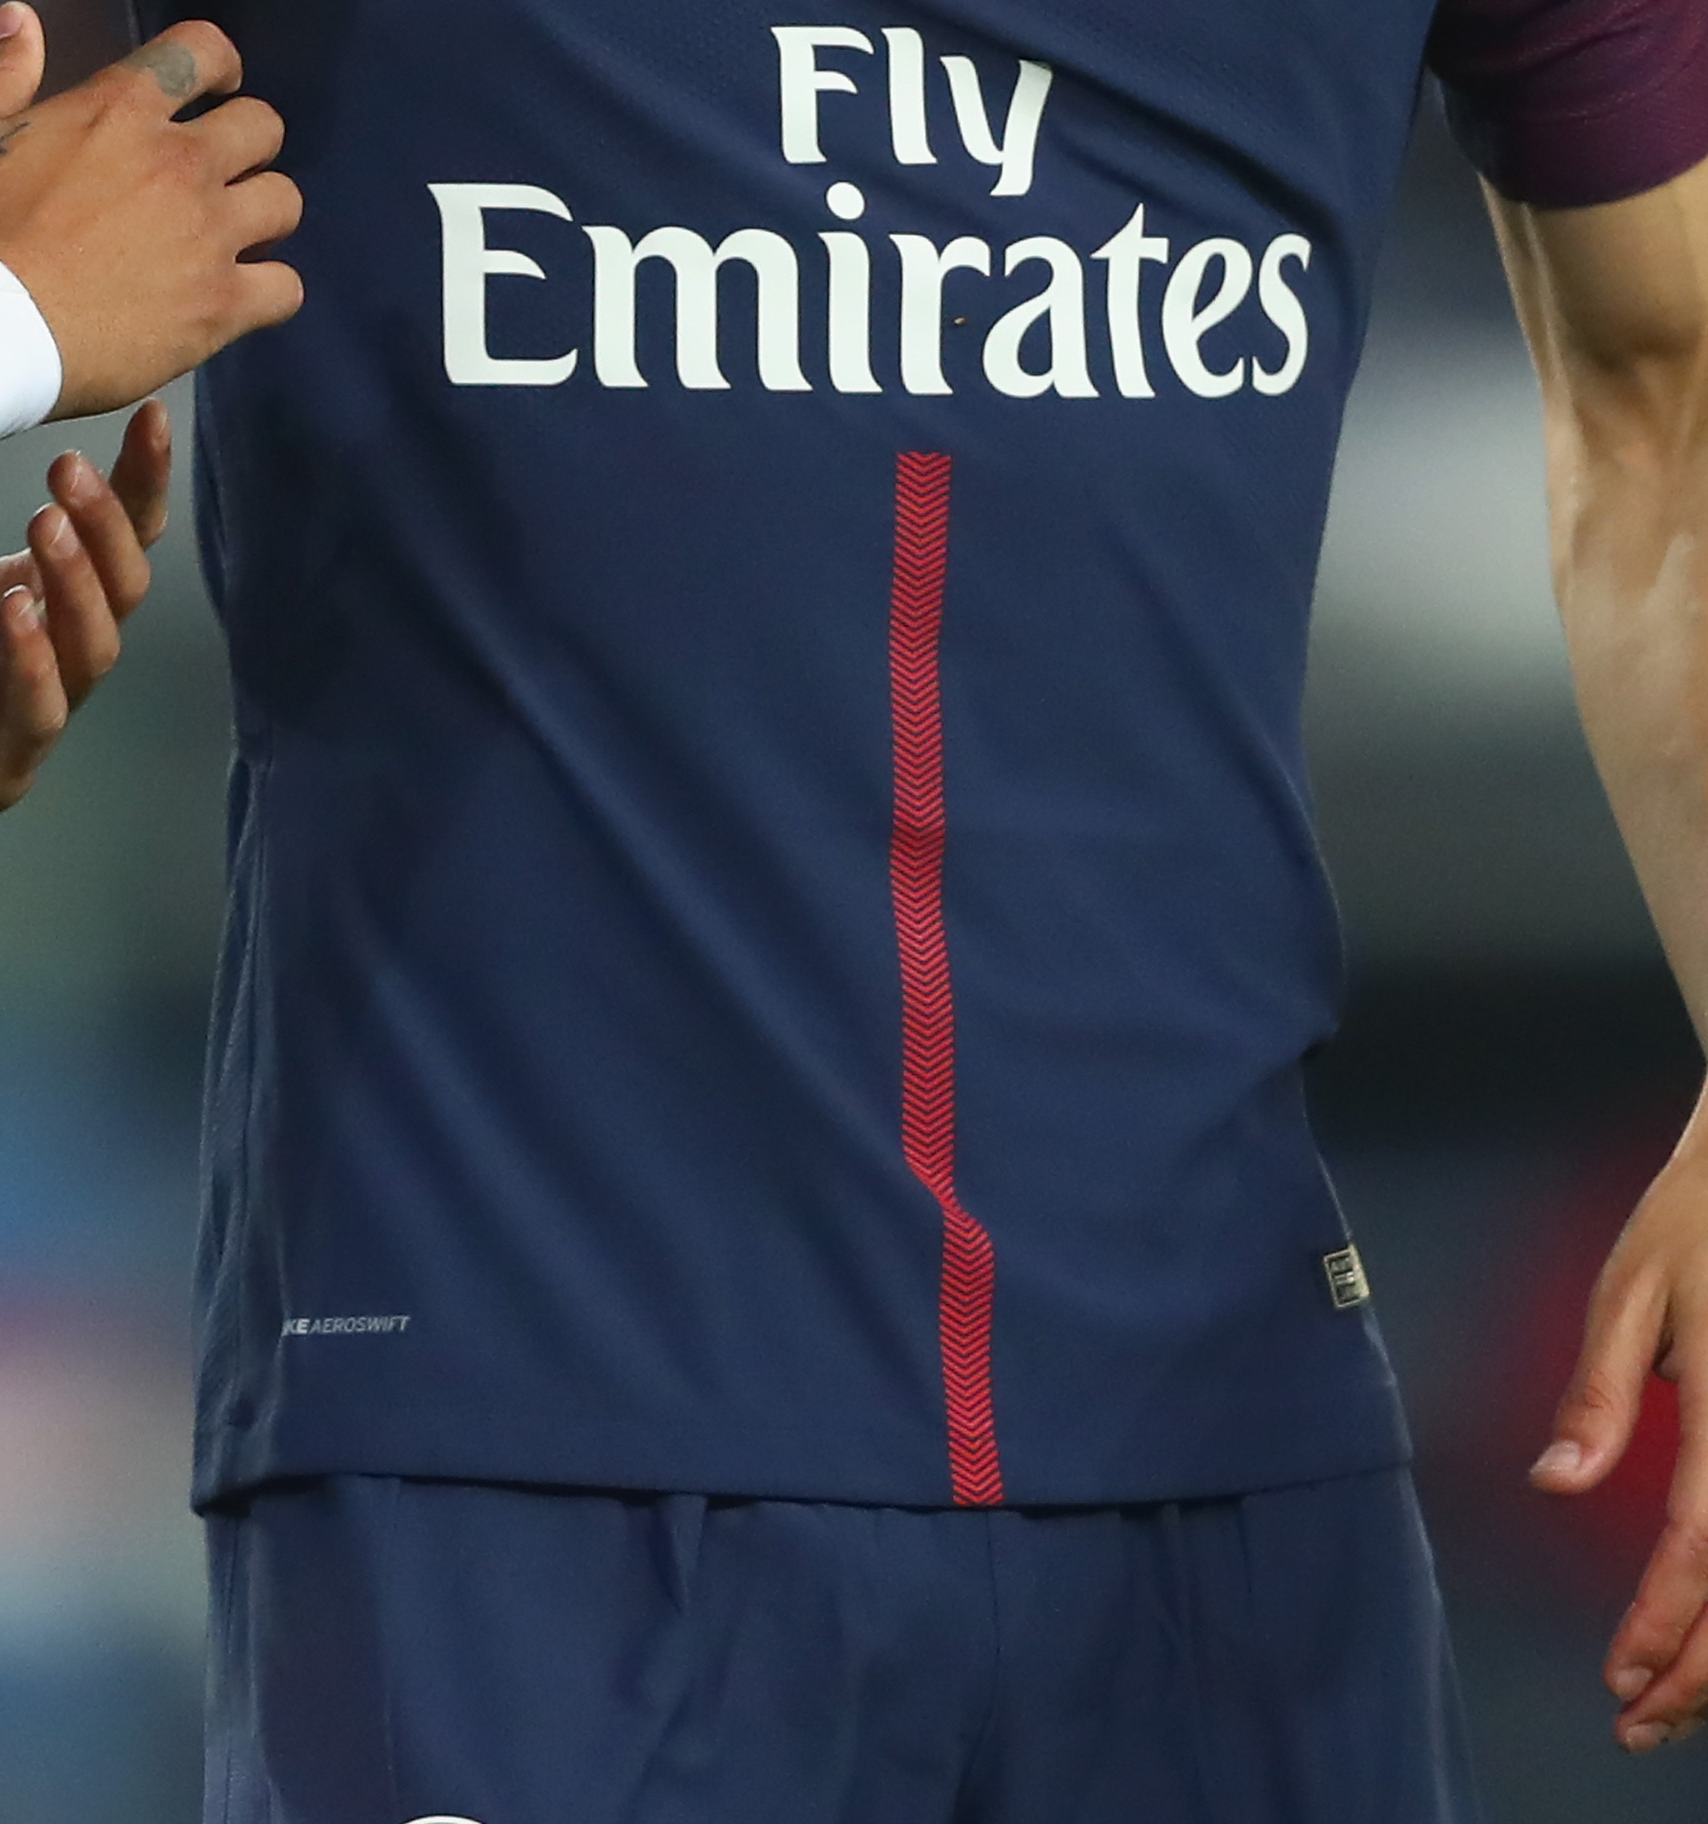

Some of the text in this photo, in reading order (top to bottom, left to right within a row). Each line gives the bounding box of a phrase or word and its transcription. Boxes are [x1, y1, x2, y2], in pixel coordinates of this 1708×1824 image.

[769, 25, 1053, 198] Fly
[426, 180, 1312, 400] Emirates
[309, 1315, 411, 1334] AEROSWIFT
